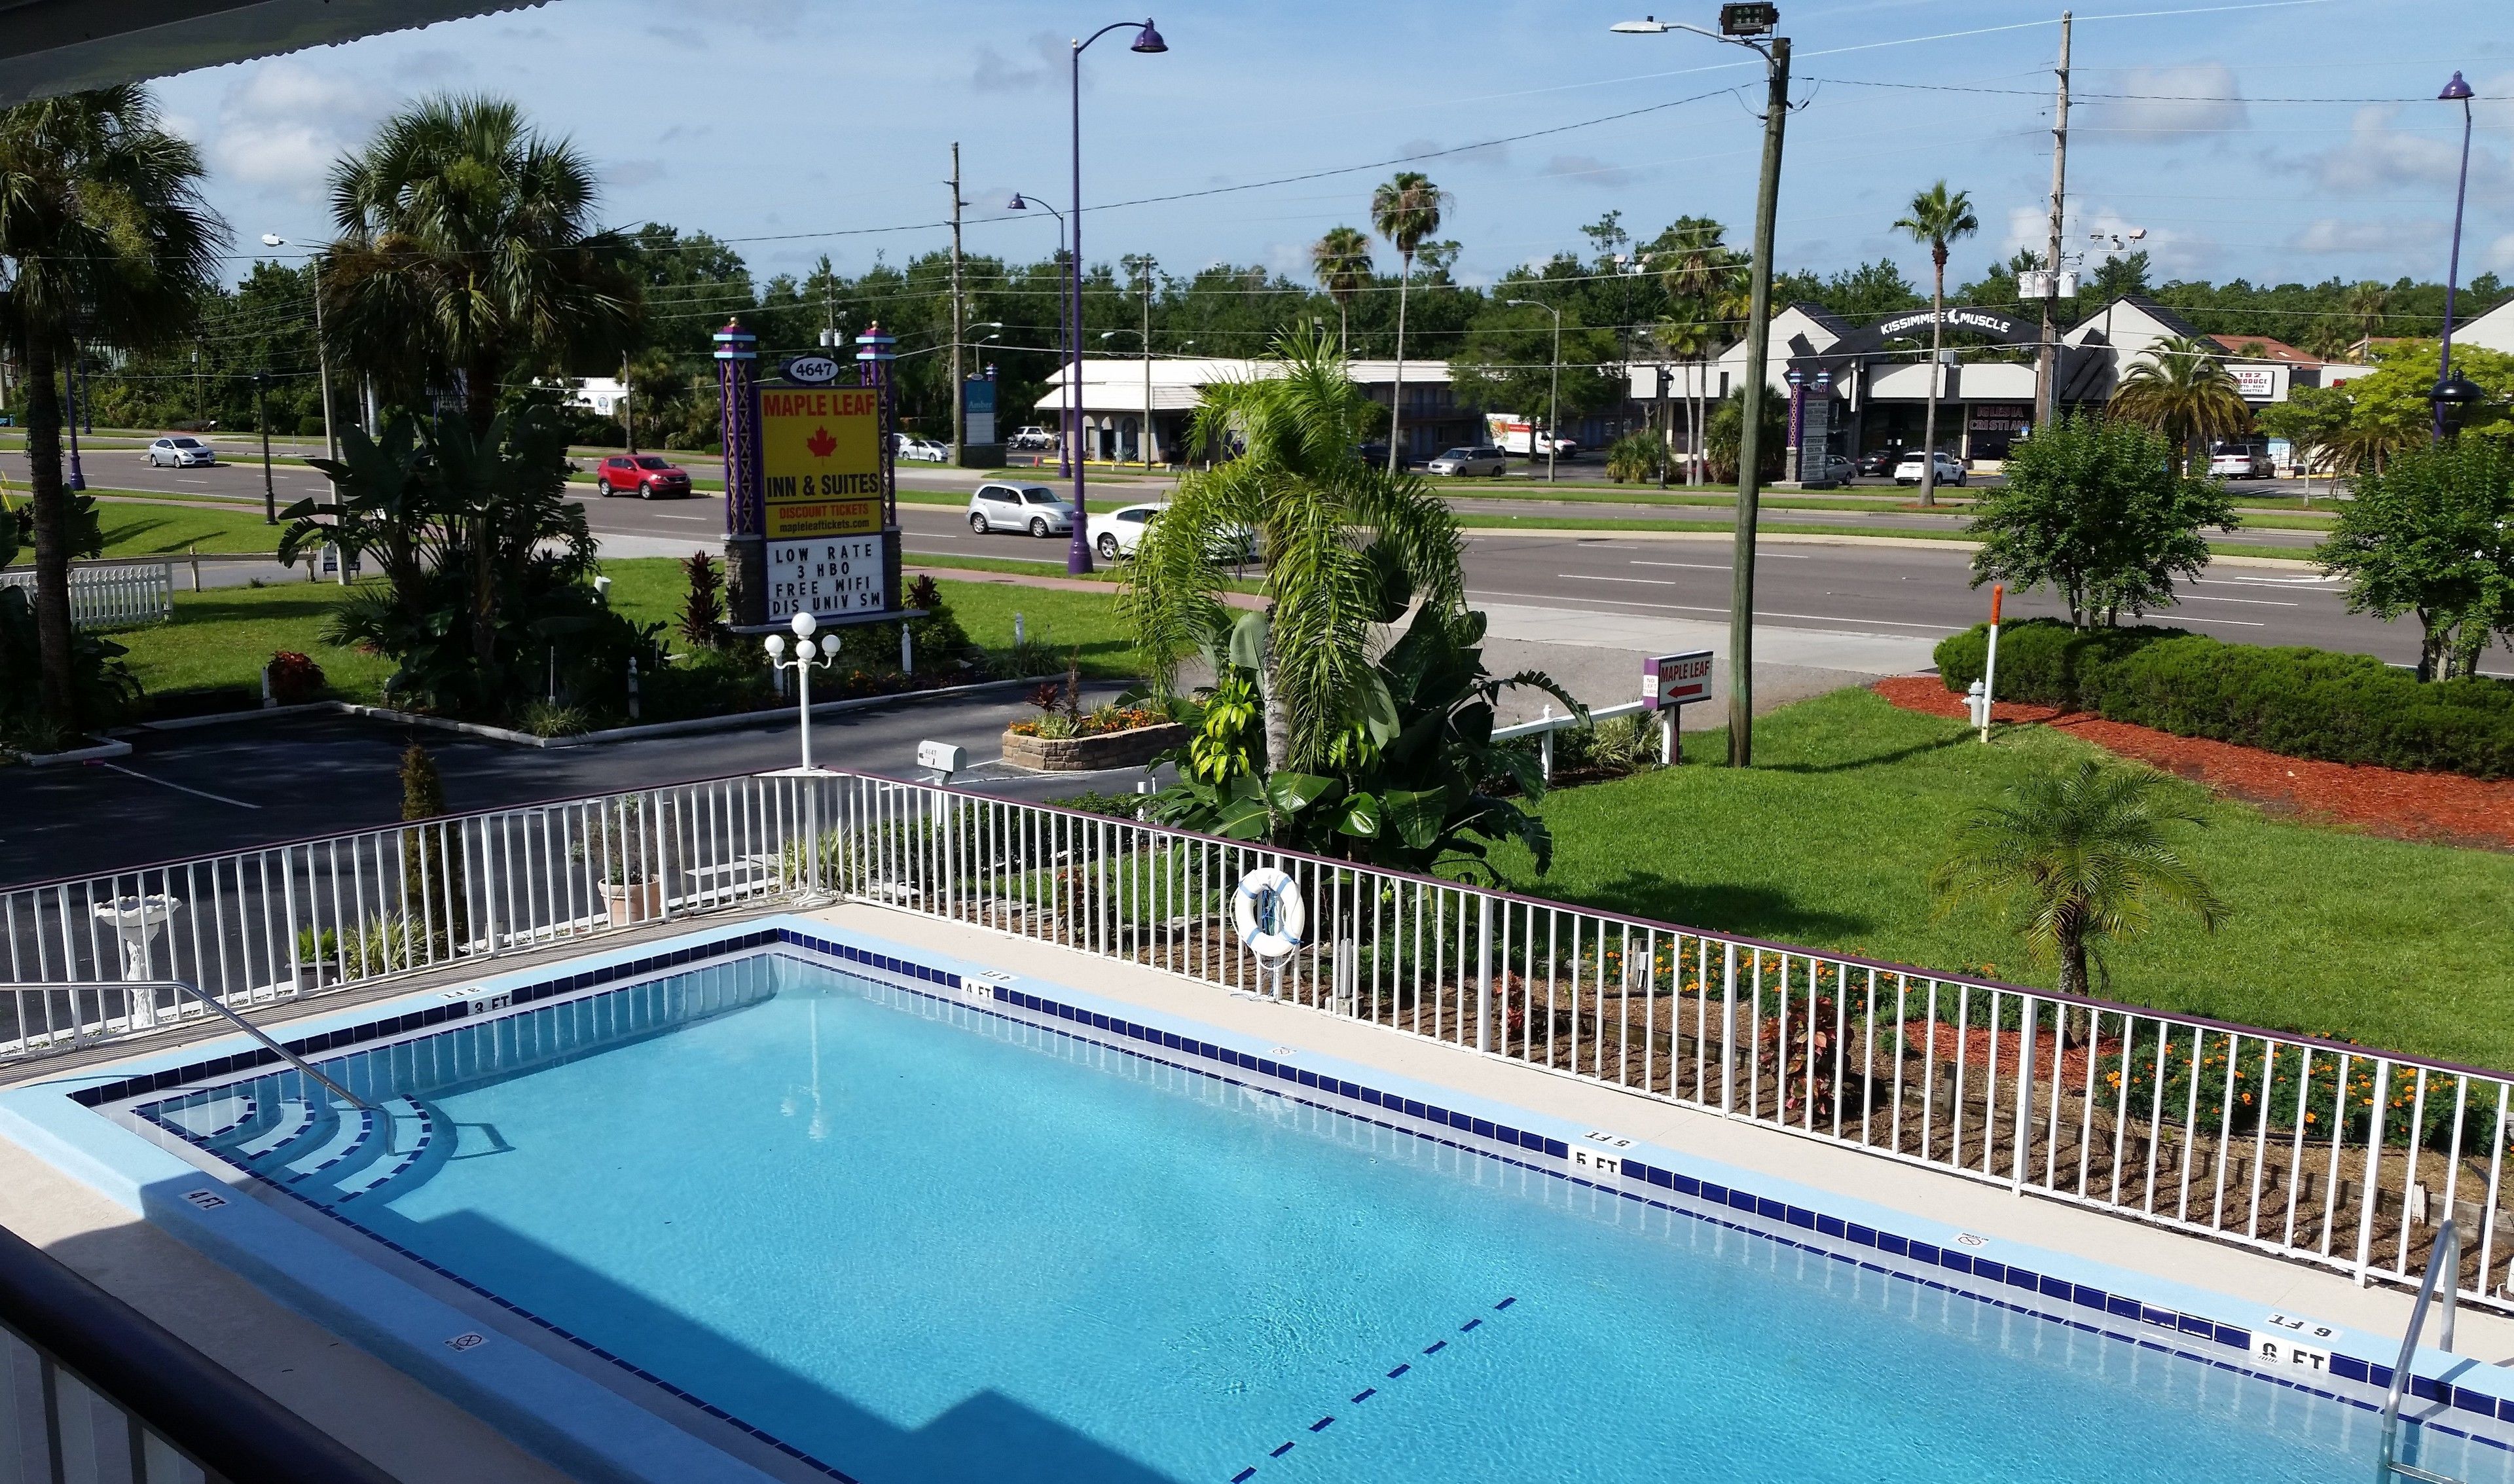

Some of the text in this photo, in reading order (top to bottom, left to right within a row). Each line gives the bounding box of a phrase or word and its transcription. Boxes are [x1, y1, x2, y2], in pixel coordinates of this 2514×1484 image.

[1880, 312, 2011, 335] KISSIMMEE MUSCLE
[796, 363, 833, 376] 4647
[763, 394, 875, 416] MAPLE LEAF
[1977, 407, 2024, 417] IGLESIA
[1969, 420, 2031, 431] CRISTIANA
[767, 473, 879, 498] INN & SUITES
[780, 503, 869, 519] DISCOUNT TICKETS
[780, 519, 869, 534] mapleleaftickets.com
[776, 544, 871, 563] LOW RATE
[797, 562, 850, 579] 3 HBO
[776, 576, 869, 597] FREE WIFI
[773, 592, 880, 614] DIS UNIV SW
[1660, 660, 1710, 683] MAPLE LEAF
[978, 985, 991, 998] FT
[475, 995, 509, 1013] 3 FT
[1576, 1151, 1617, 1173] 5 FT
[2314, 1328, 2332, 1337] 6
[2293, 1348, 2325, 1370] FT
